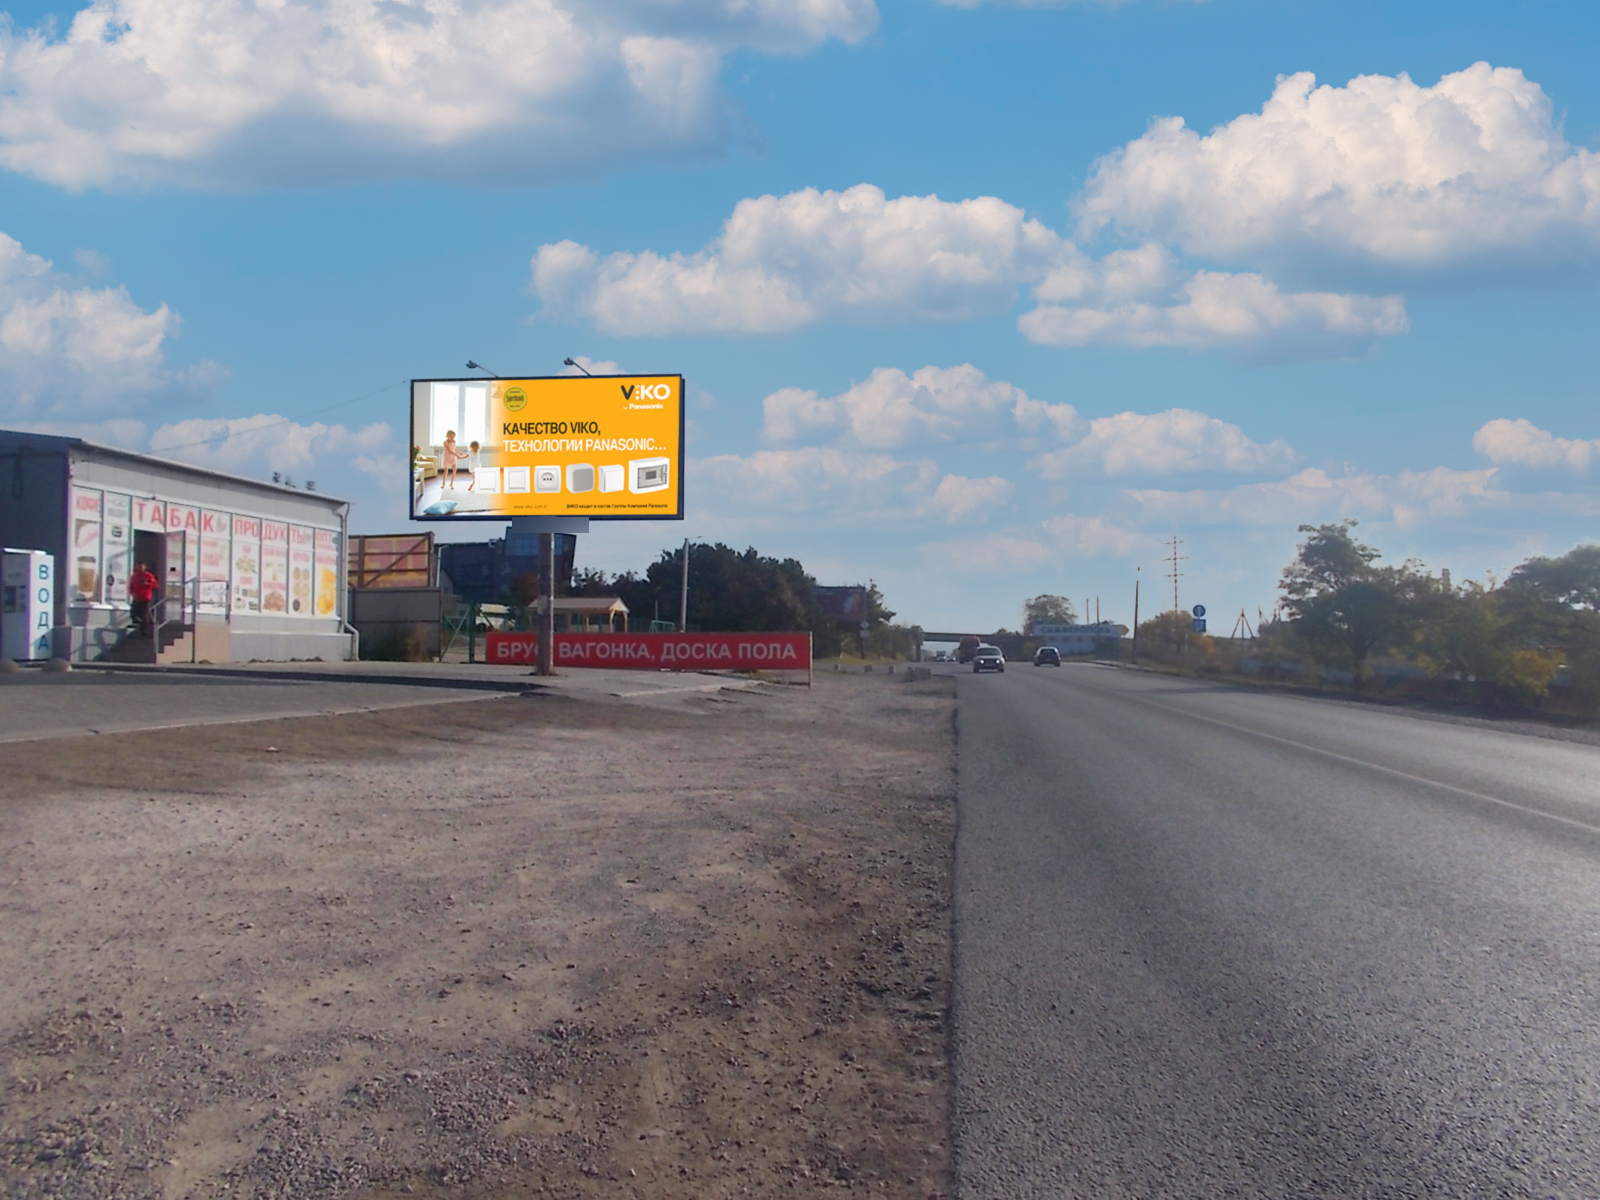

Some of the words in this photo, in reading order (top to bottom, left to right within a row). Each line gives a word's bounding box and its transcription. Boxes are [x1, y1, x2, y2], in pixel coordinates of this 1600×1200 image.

[503, 422, 567, 436] КАЧЕСТВО
[570, 421, 601, 436] VIKO,
[503, 439, 582, 452] ТЕХНОЛОГИИ
[135, 501, 215, 532] ТАБАК
[234, 520, 305, 545] ПРОДУКТЫ
[37, 564, 50, 650] ВОДА
[497, 642, 539, 659] БРУ
[559, 642, 654, 661] ВАГОНКА,
[661, 642, 732, 661] ДОСКА
[738, 642, 797, 660] ПОЛА
